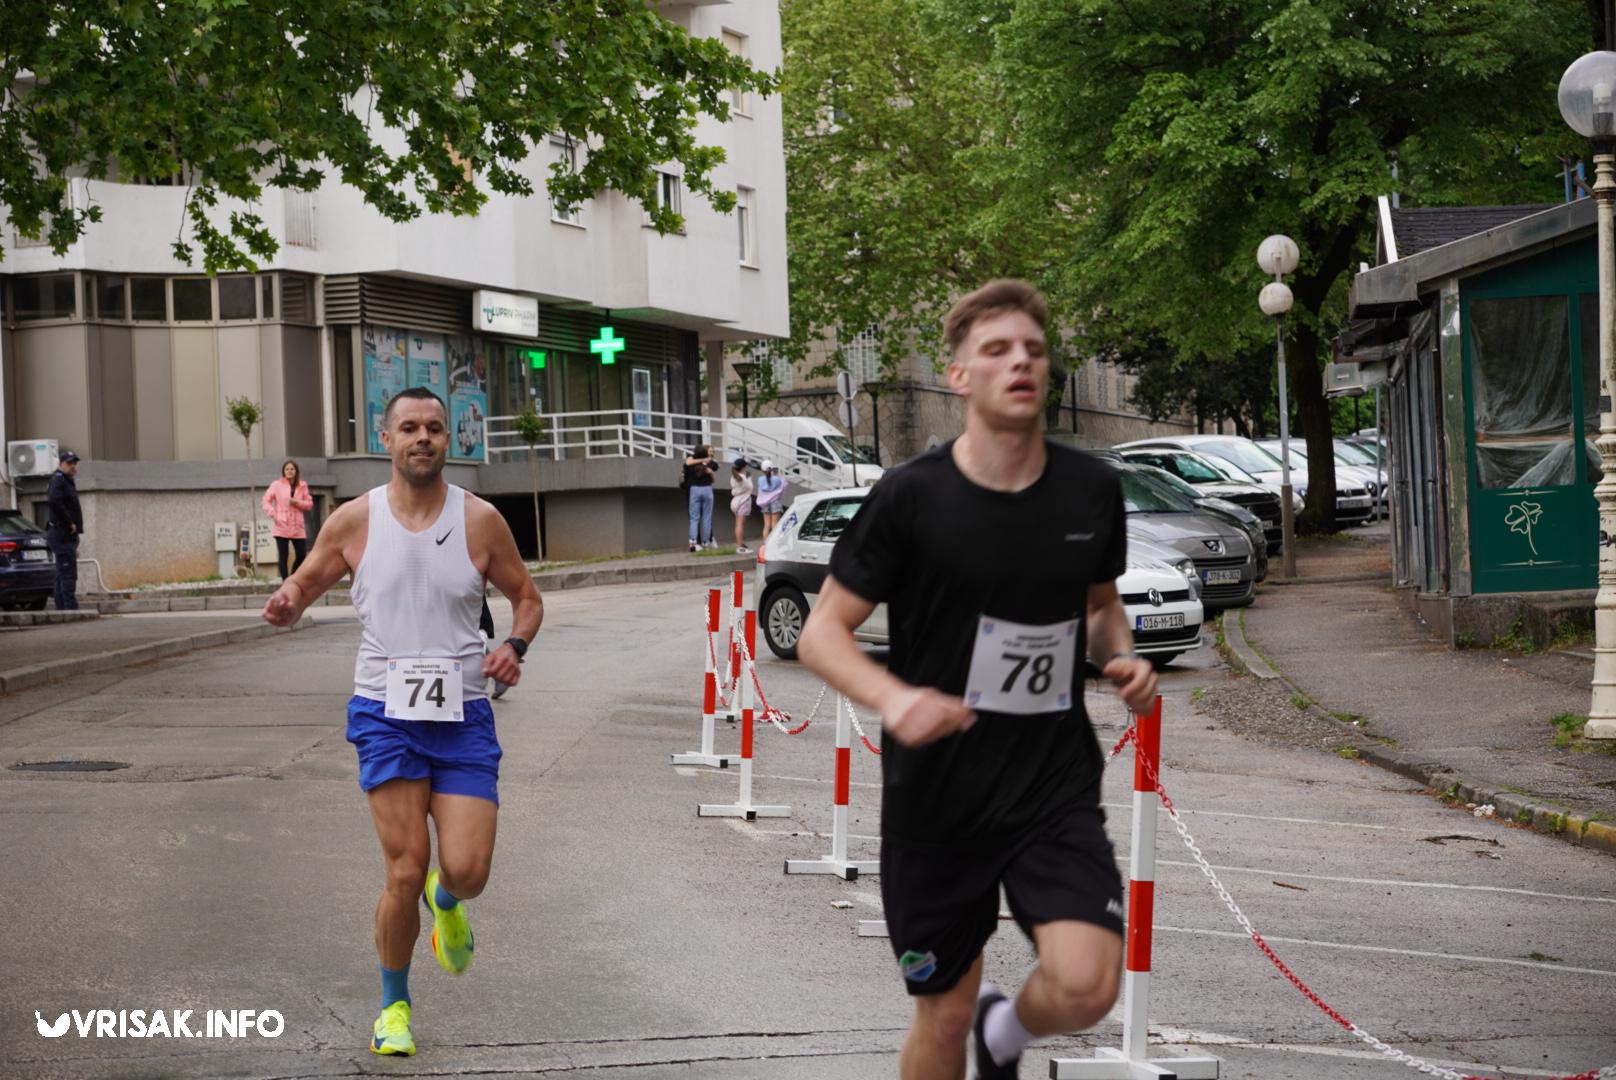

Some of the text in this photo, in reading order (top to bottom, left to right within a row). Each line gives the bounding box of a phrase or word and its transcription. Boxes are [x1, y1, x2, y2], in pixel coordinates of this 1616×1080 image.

[1143, 615, 1183, 628] 016-M-118
[1000, 652, 1054, 695] 78
[405, 678, 446, 708] 74
